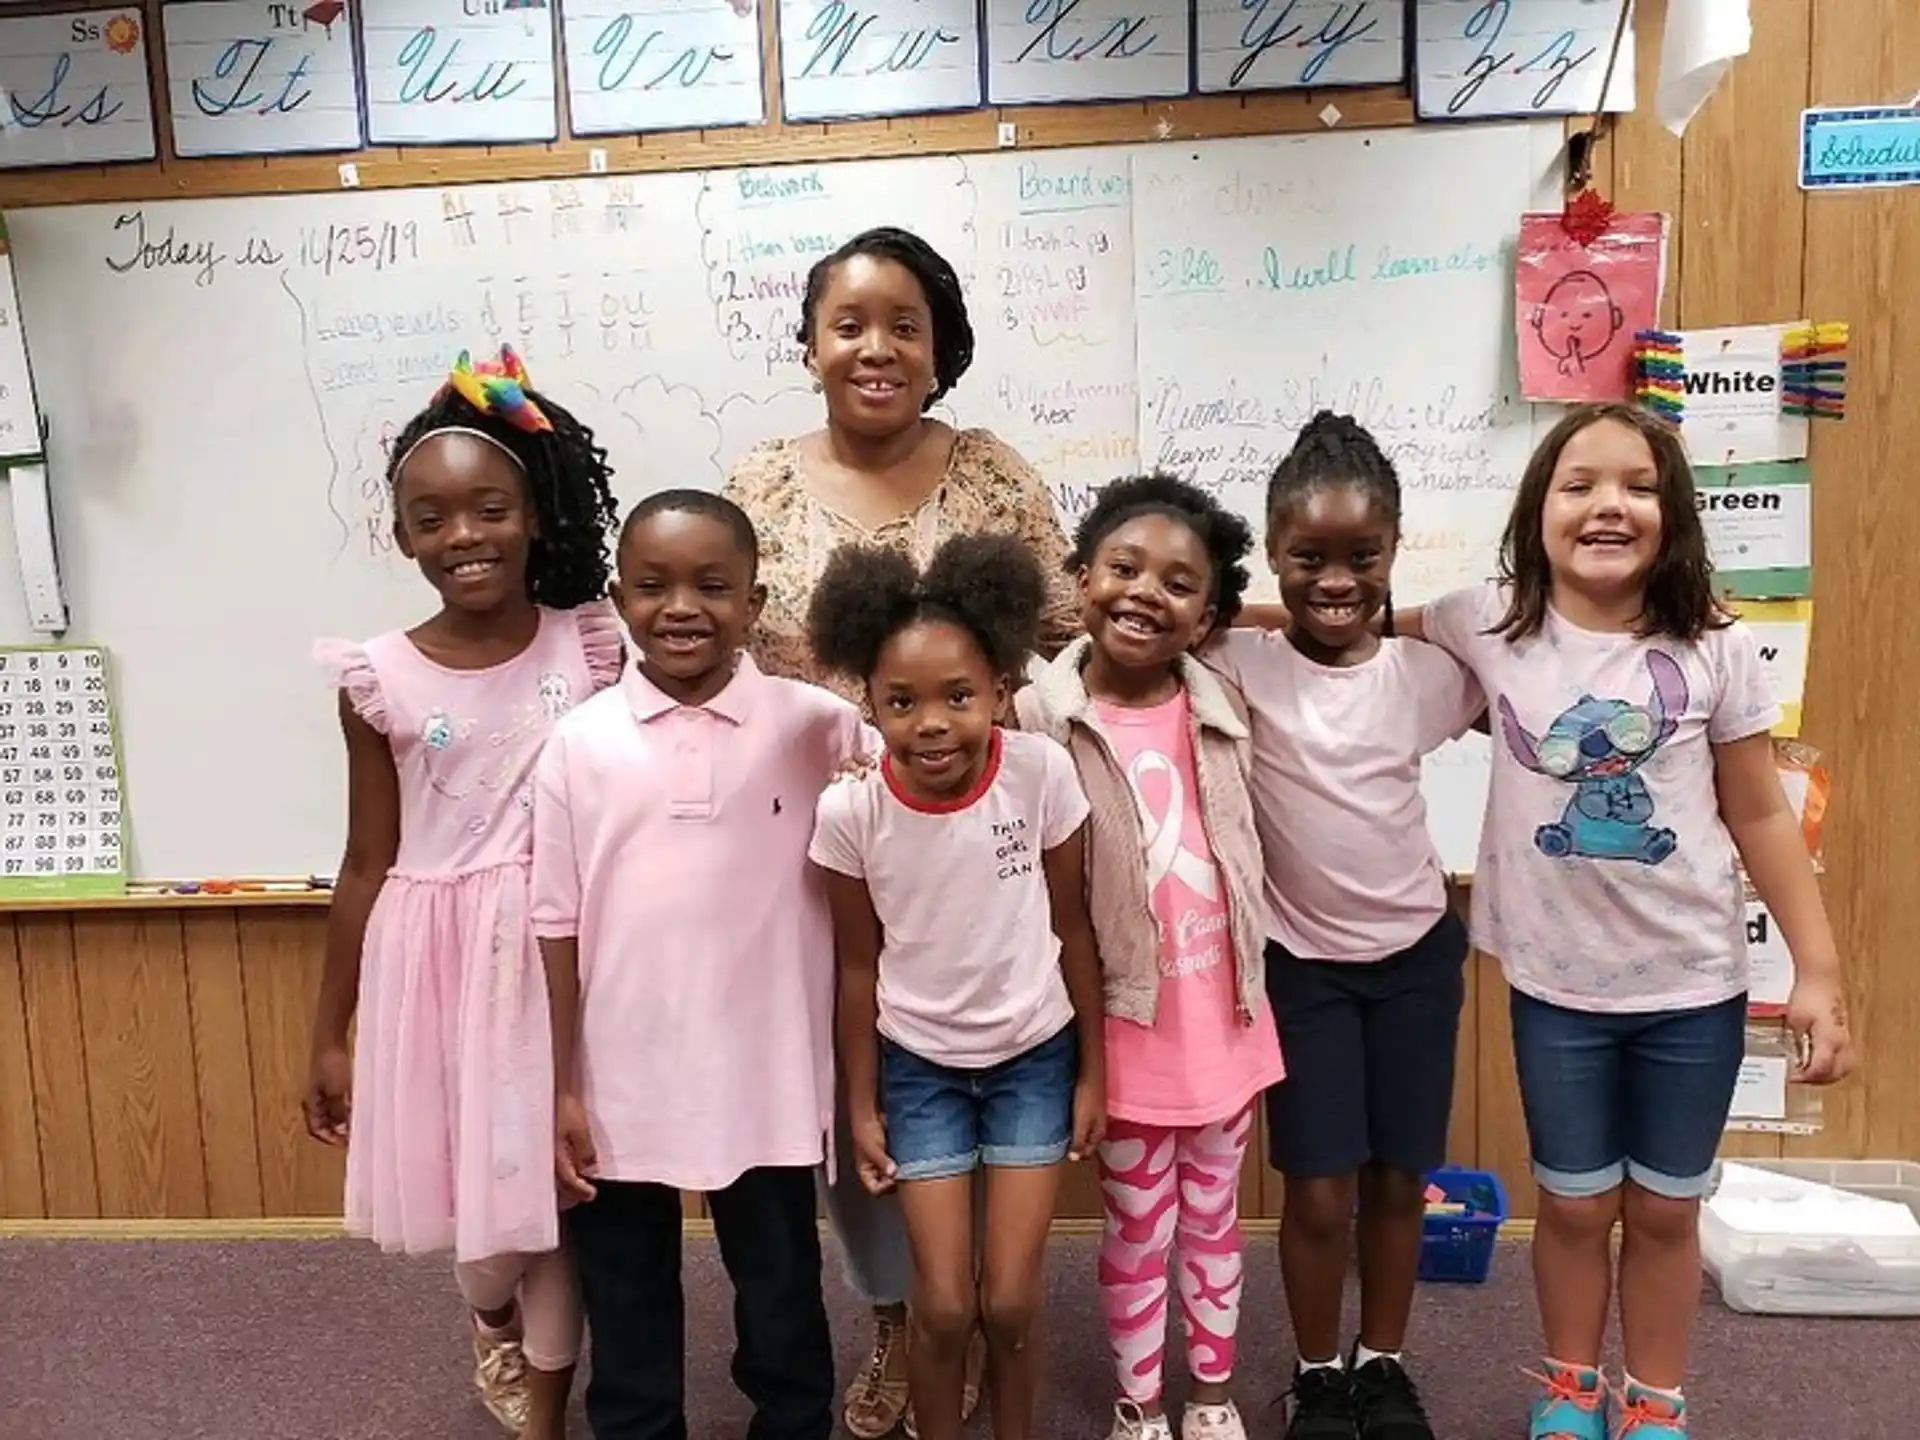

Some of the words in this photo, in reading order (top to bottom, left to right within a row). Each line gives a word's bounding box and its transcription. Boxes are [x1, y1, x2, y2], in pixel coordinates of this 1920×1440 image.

[267, 4, 298, 28] Tt
[72, 18, 100, 42] Ss
[105, 210, 227, 287] Today
[234, 235, 283, 265] is
[1683, 371, 1774, 395] White
[1694, 491, 1781, 511] Green
[998, 862, 1032, 880] CAN
